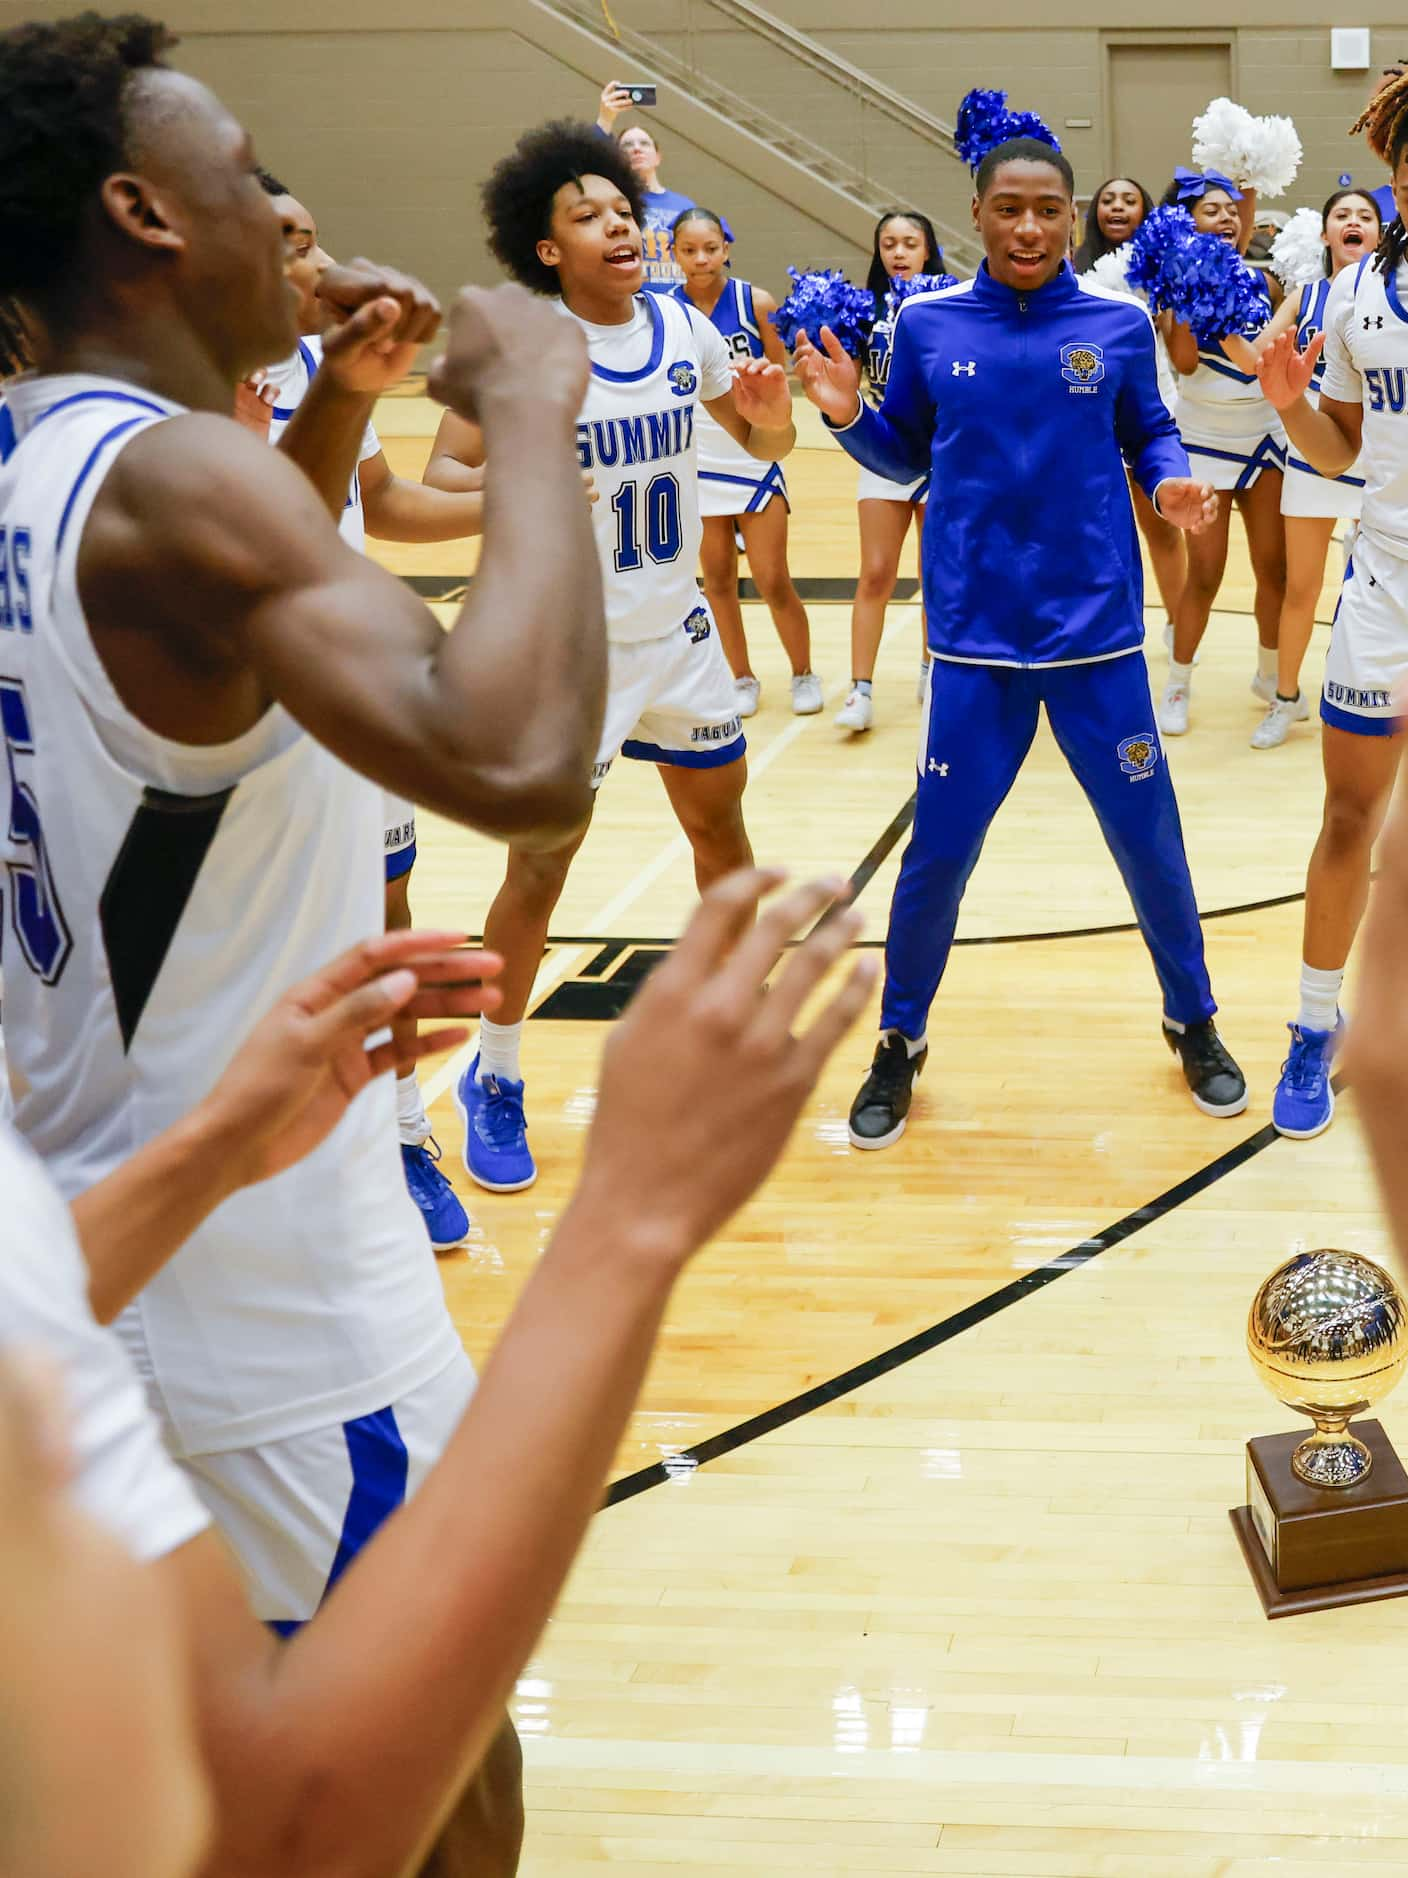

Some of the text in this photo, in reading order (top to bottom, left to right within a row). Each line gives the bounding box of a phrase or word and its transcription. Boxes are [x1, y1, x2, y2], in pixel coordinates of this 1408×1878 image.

[576, 402, 694, 469] SUMMIT
[611, 471, 683, 573] 10
[1327, 680, 1391, 708] SUMMIT
